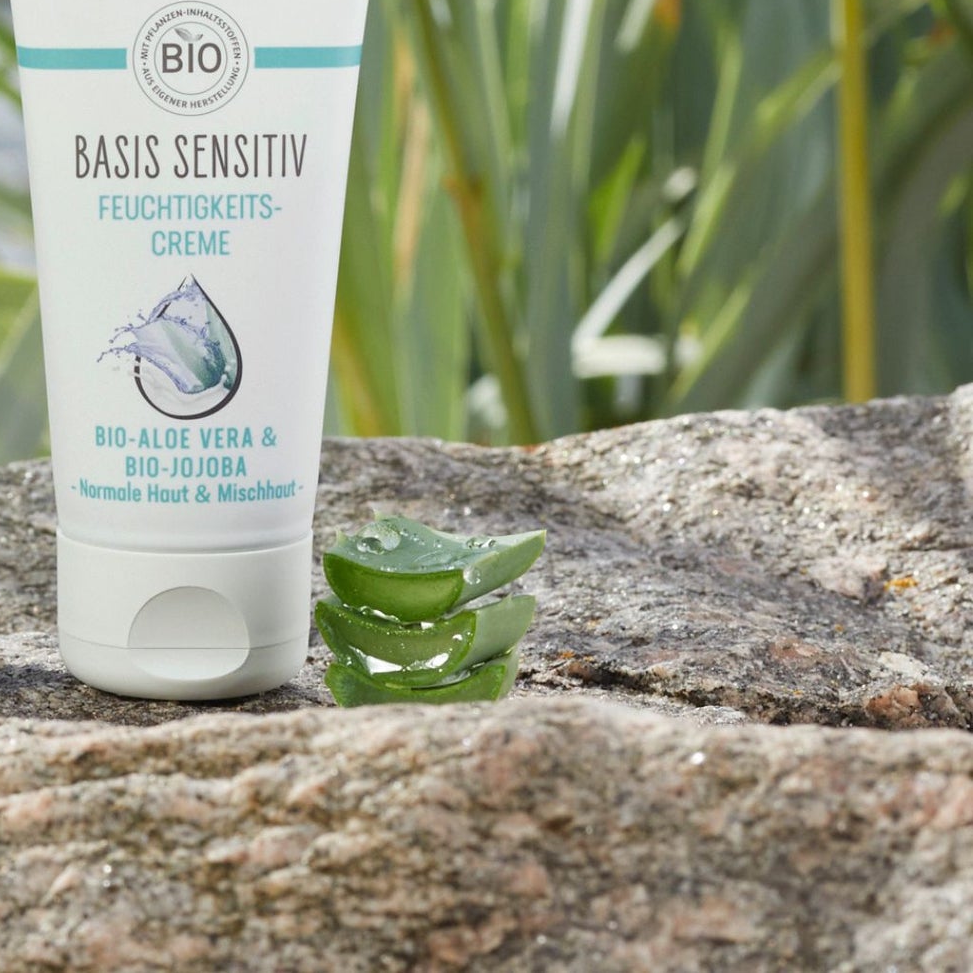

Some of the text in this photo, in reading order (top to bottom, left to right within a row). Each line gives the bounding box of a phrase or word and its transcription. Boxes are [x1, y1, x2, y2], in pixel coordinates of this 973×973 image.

[140, 42, 149, 60] MIT
[161, 42, 222, 74] BIO
[142, 67, 240, 109] AUS EIGENER HERSTELLUNG
[75, 133, 308, 180] BASIS SENSITIV
[98, 193, 282, 222] FEUCHTIGKEITS-
[151, 229, 231, 257] CREME
[94, 425, 277, 450] BIO-ALOE VERA &
[125, 455, 247, 479] BIO-JOJOBA
[79, 478, 142, 503] Normale
[147, 483, 190, 504] Haut
[194, 484, 212, 504] &
[217, 479, 296, 503] Mischhaut
